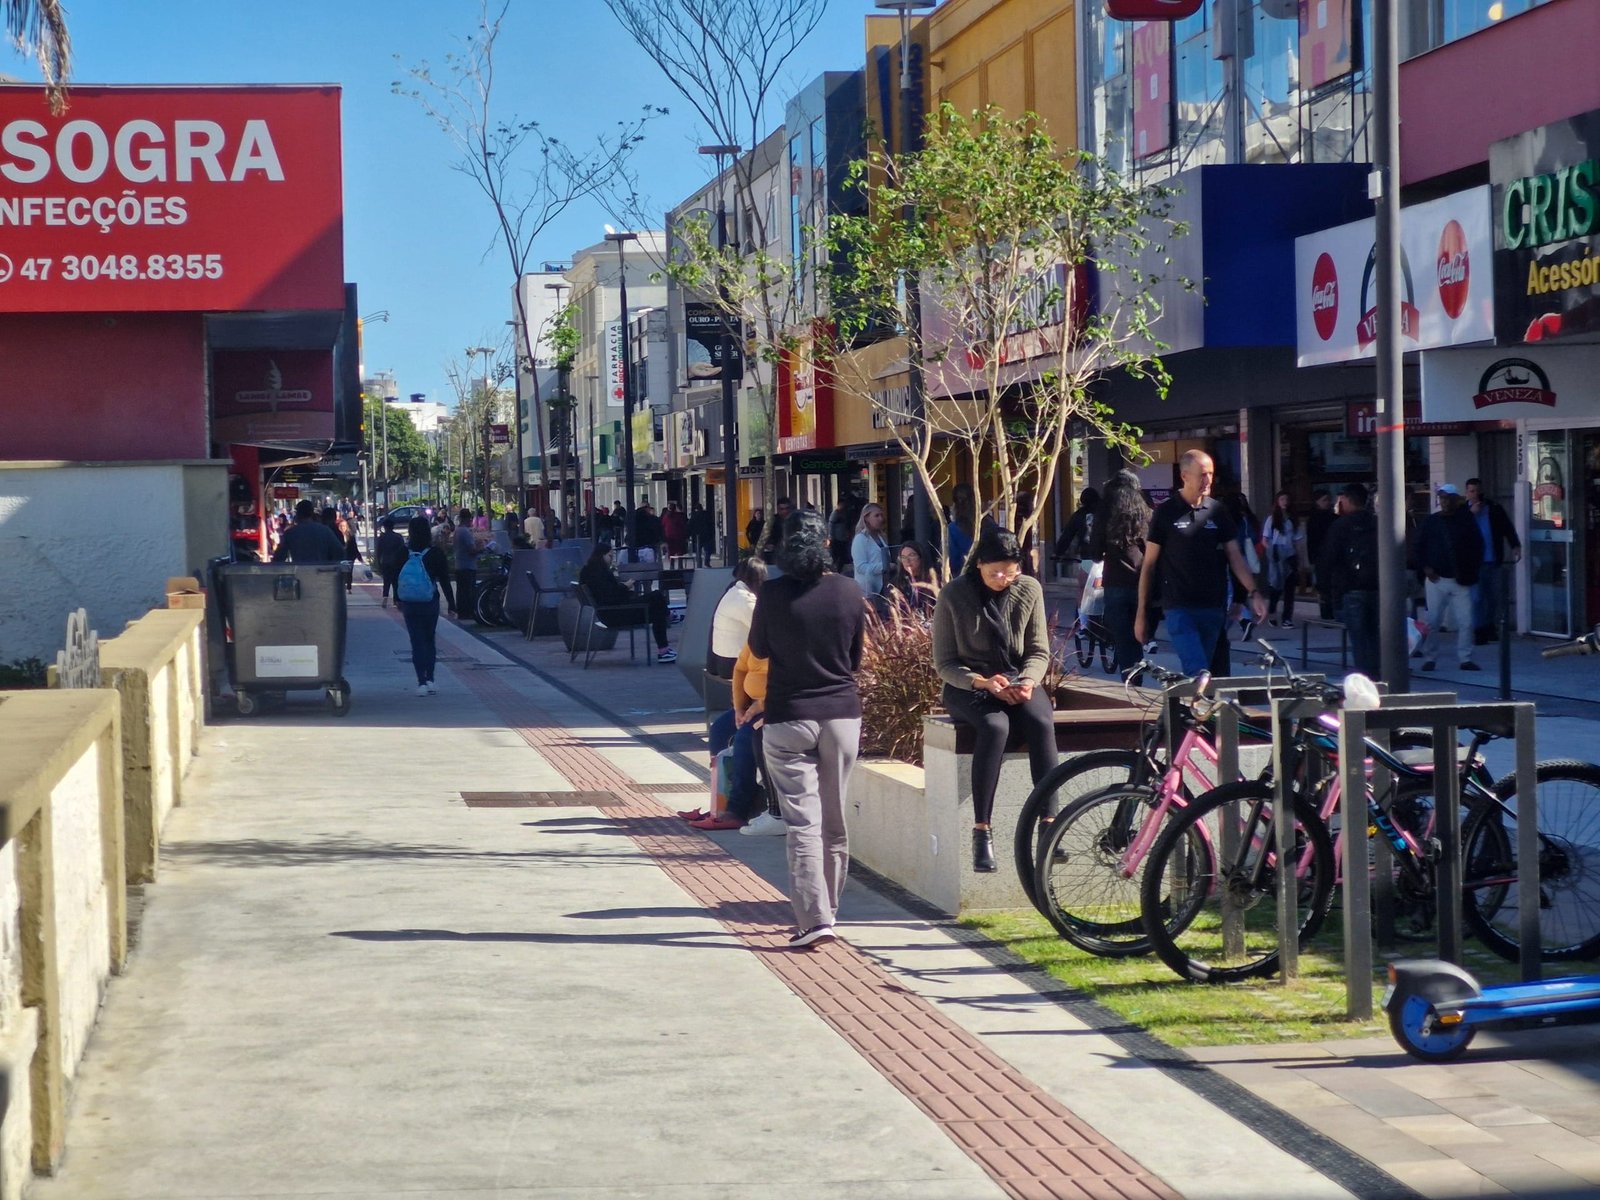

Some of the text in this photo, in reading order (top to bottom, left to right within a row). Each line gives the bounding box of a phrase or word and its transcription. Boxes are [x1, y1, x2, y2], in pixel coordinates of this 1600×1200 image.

[0, 119, 286, 184] SOGRA
[0, 190, 188, 233] NFECÇÕES
[1503, 161, 1597, 251] CRIS
[20, 254, 223, 281] 47 3048.8355
[1438, 250, 1470, 288] Coca-Cola
[611, 325, 619, 384] FARMACIA
[1482, 389, 1544, 402] VENEZA
[740, 466, 764, 475] ZION
